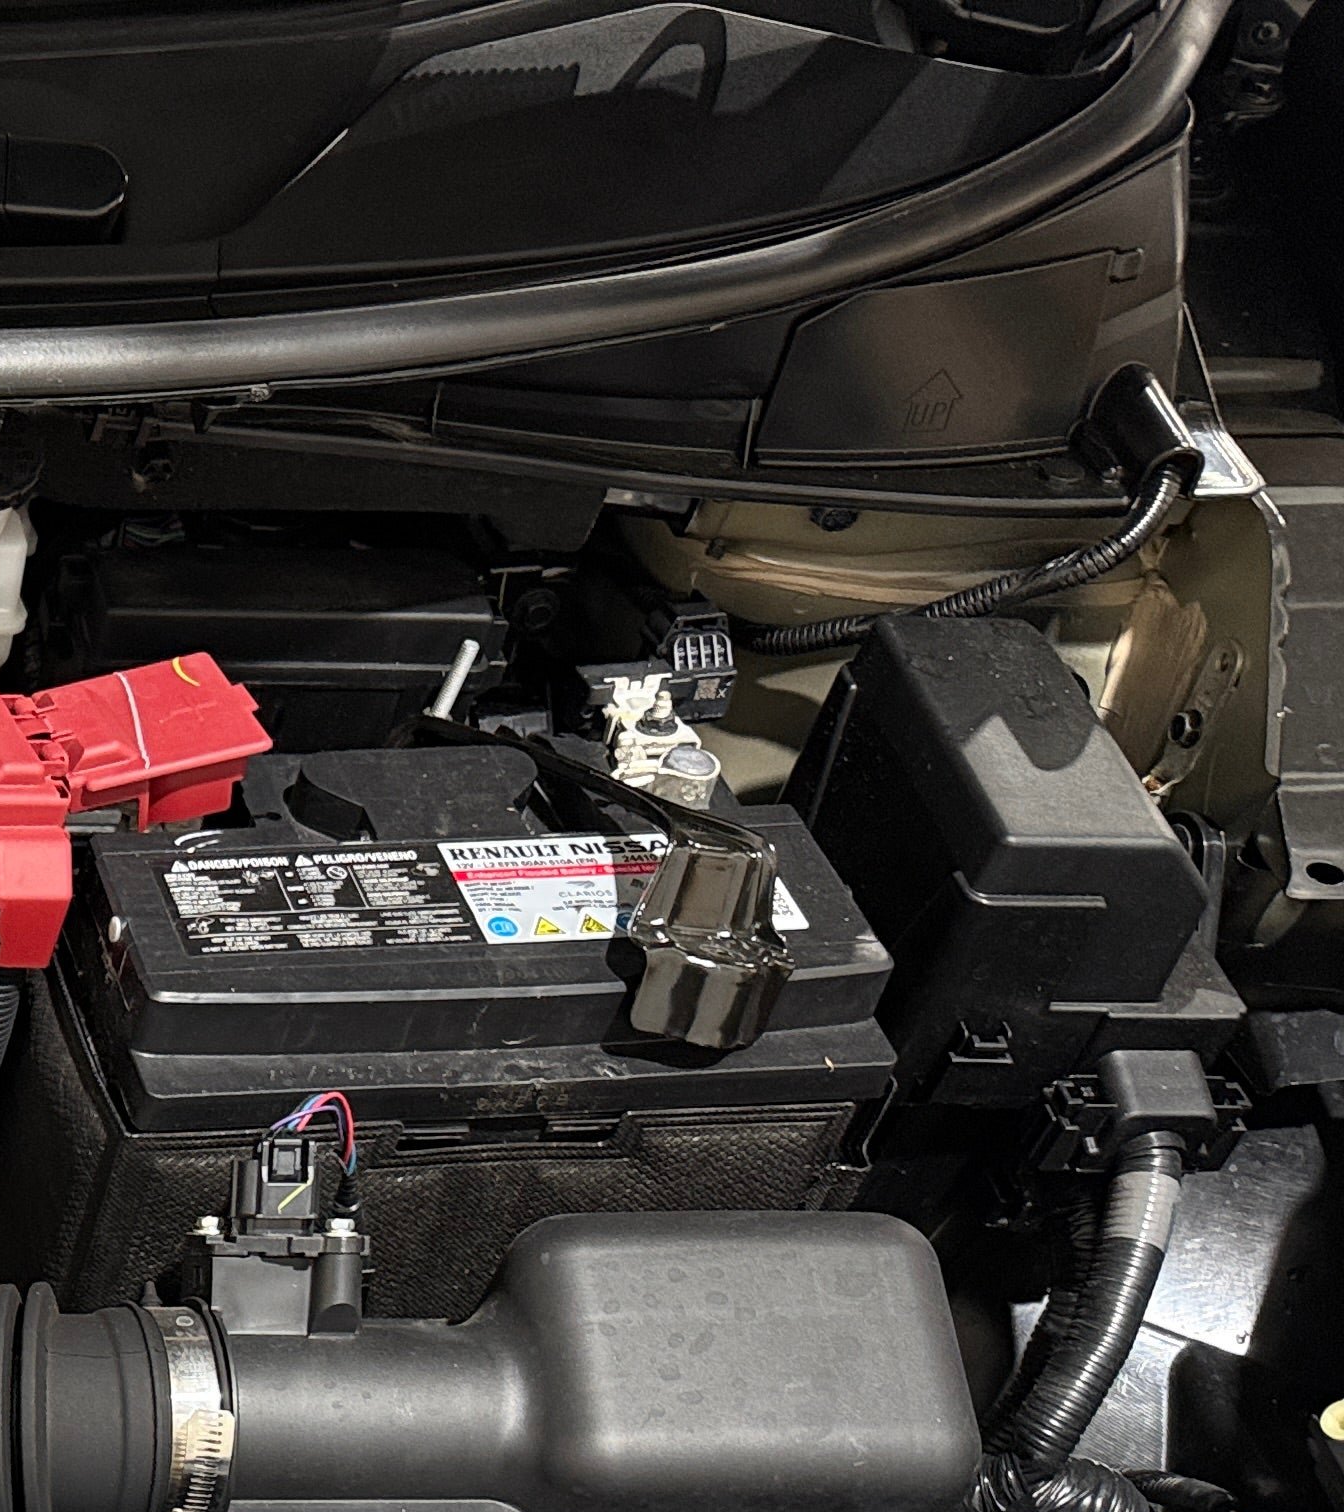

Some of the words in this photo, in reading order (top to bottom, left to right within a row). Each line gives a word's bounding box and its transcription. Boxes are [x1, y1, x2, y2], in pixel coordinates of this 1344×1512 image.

[188, 856, 290, 871] DANGER/POISON
[313, 849, 418, 865] PELIGRO/VENENO
[448, 844, 561, 861] RENAULT
[569, 840, 669, 856] NISSA
[558, 889, 614, 899] CLARIOS
